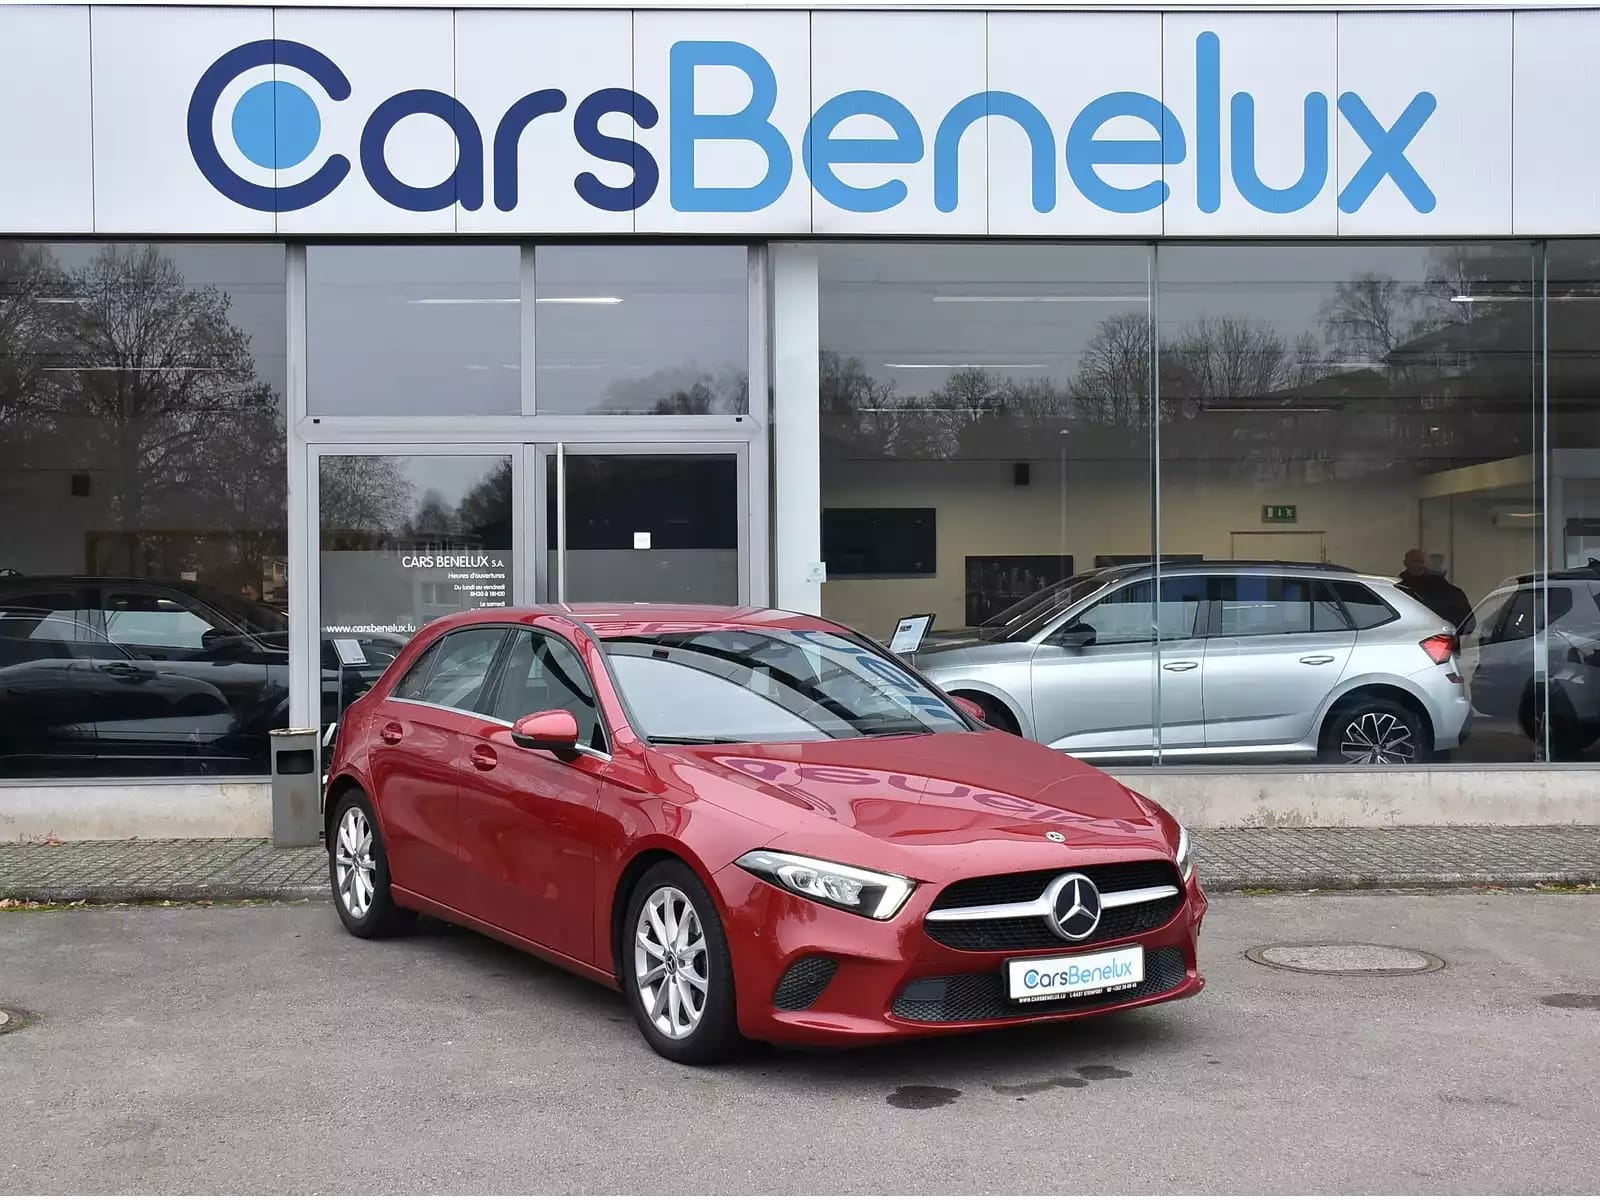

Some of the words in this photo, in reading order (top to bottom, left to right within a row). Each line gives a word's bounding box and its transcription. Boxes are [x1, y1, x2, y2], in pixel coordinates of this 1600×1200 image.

[188, 31, 1437, 214] CarsBenelux
[402, 556, 433, 568] CARS
[436, 556, 489, 568] BENELUX
[326, 623, 416, 633] www.carsbenelux.lu
[1024, 958, 1132, 989] CarsBenelux
